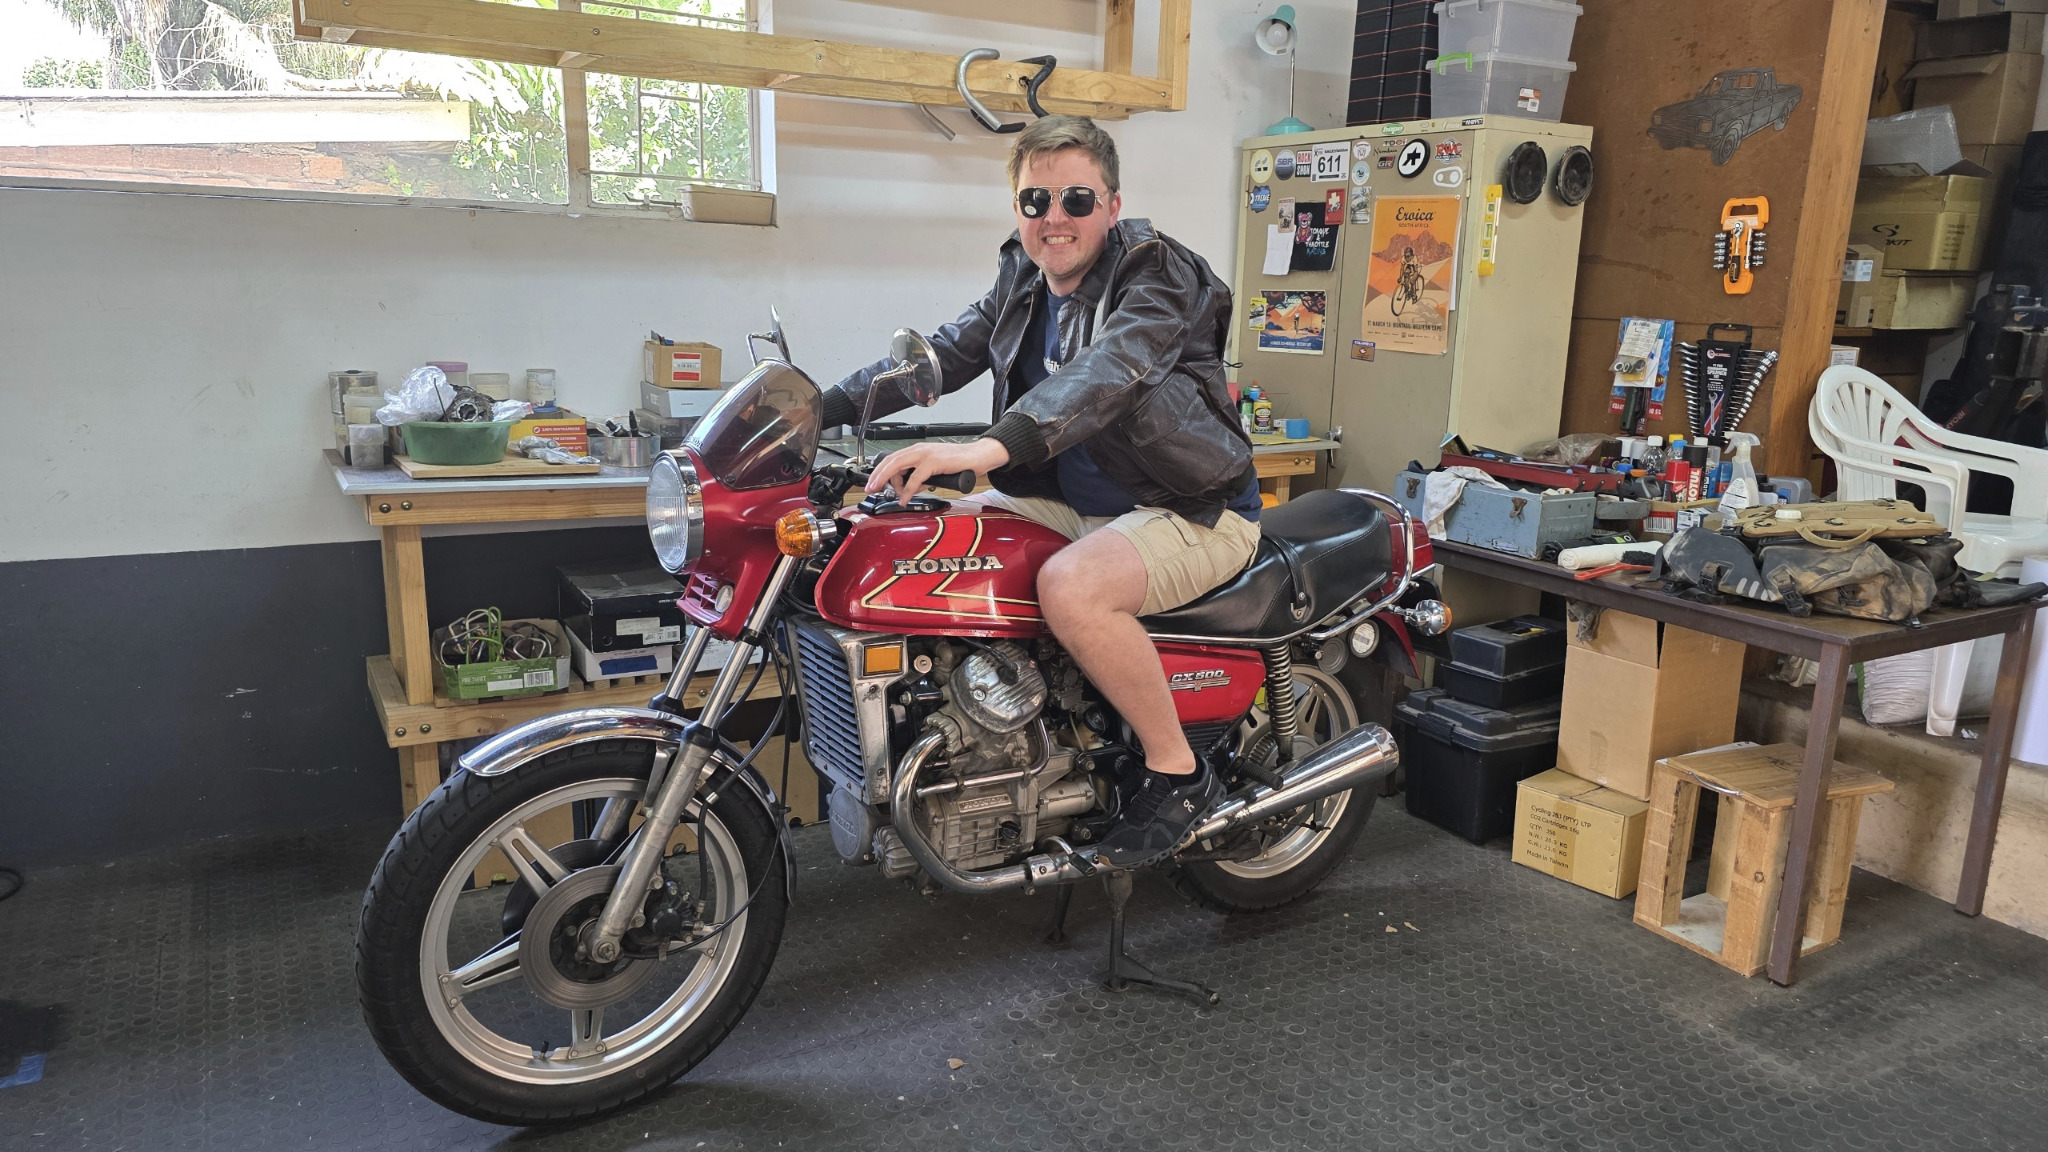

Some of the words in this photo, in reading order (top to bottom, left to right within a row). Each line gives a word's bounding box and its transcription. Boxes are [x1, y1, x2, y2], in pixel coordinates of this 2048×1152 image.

[1382, 125, 1404, 134] hope
[1317, 155, 1342, 173] 611
[1395, 206, 1434, 221] Eroica
[893, 555, 1004, 575] HONDA
[963, 797, 1008, 810] HONDA
[1530, 813, 1542, 822] CO2
[1541, 817, 1568, 831] Cartridges
[1531, 805, 1551, 816] Cycling
[1562, 814, 1579, 826] (PTY)
[1526, 849, 1541, 859] Made
[1548, 857, 1569, 868] Taiwan
